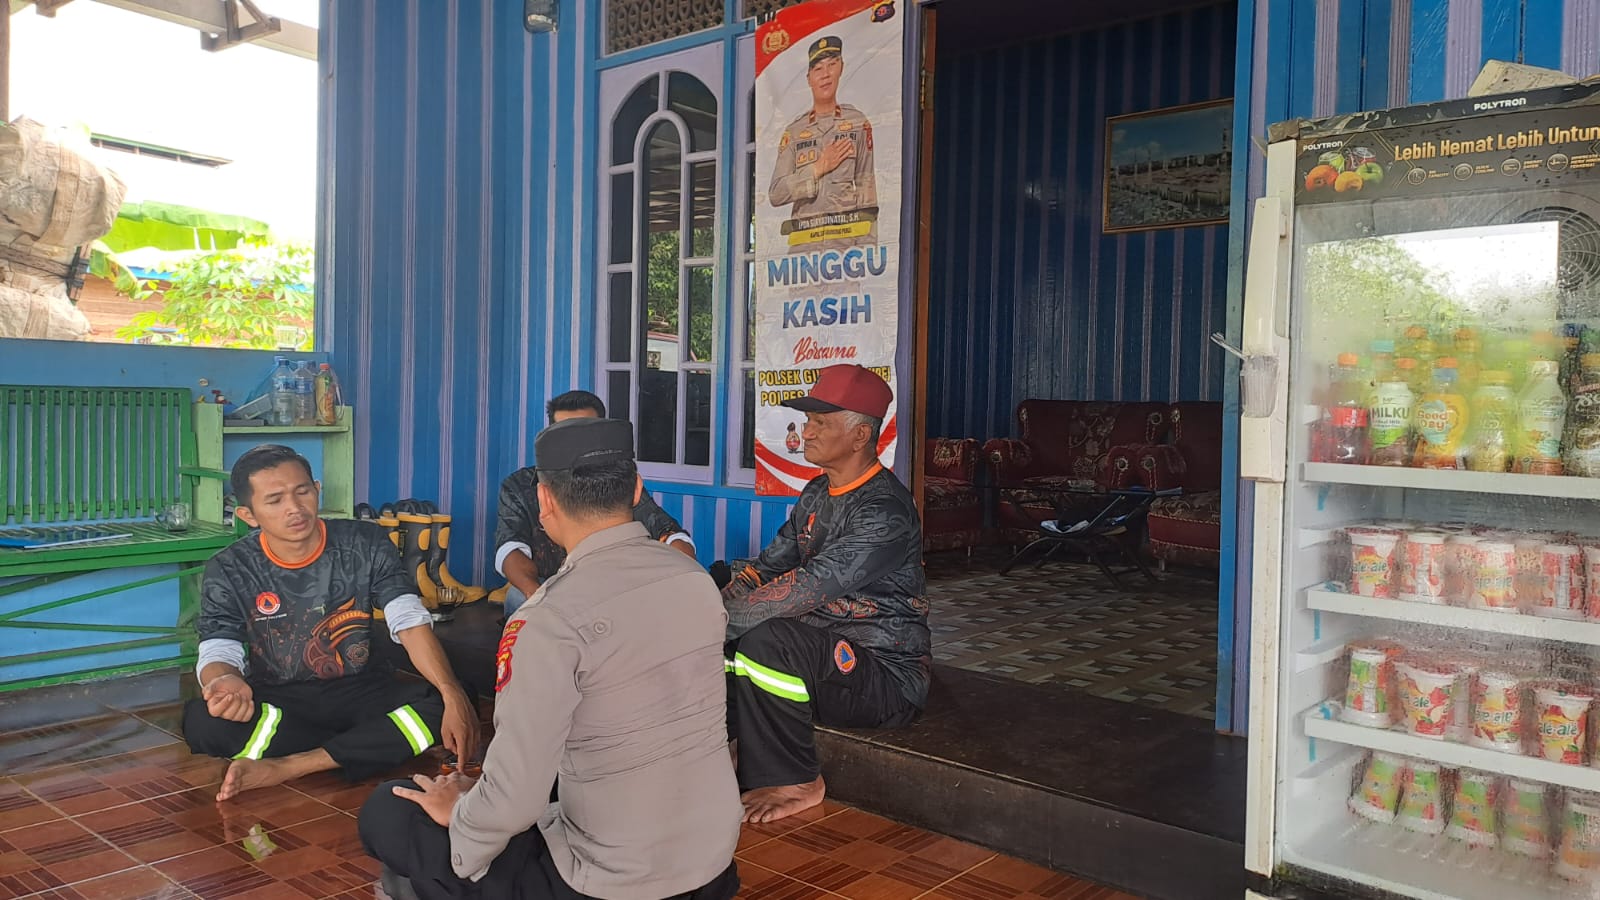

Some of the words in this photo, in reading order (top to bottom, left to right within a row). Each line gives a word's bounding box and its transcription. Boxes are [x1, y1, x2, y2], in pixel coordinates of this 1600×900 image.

[1474, 97, 1527, 111] POLYTRON
[1303, 140, 1343, 152] POLYTRON
[1395, 142, 1436, 161] Lebih
[1439, 135, 1494, 157] Hemat
[1497, 129, 1544, 151] Lebih
[767, 246, 887, 287] MINGGU
[782, 294, 872, 329] KASIH
[758, 369, 802, 386] POLSEK
[1371, 407, 1410, 419] MILKU
[1417, 410, 1448, 420] Good
[1420, 419, 1445, 431] Day
